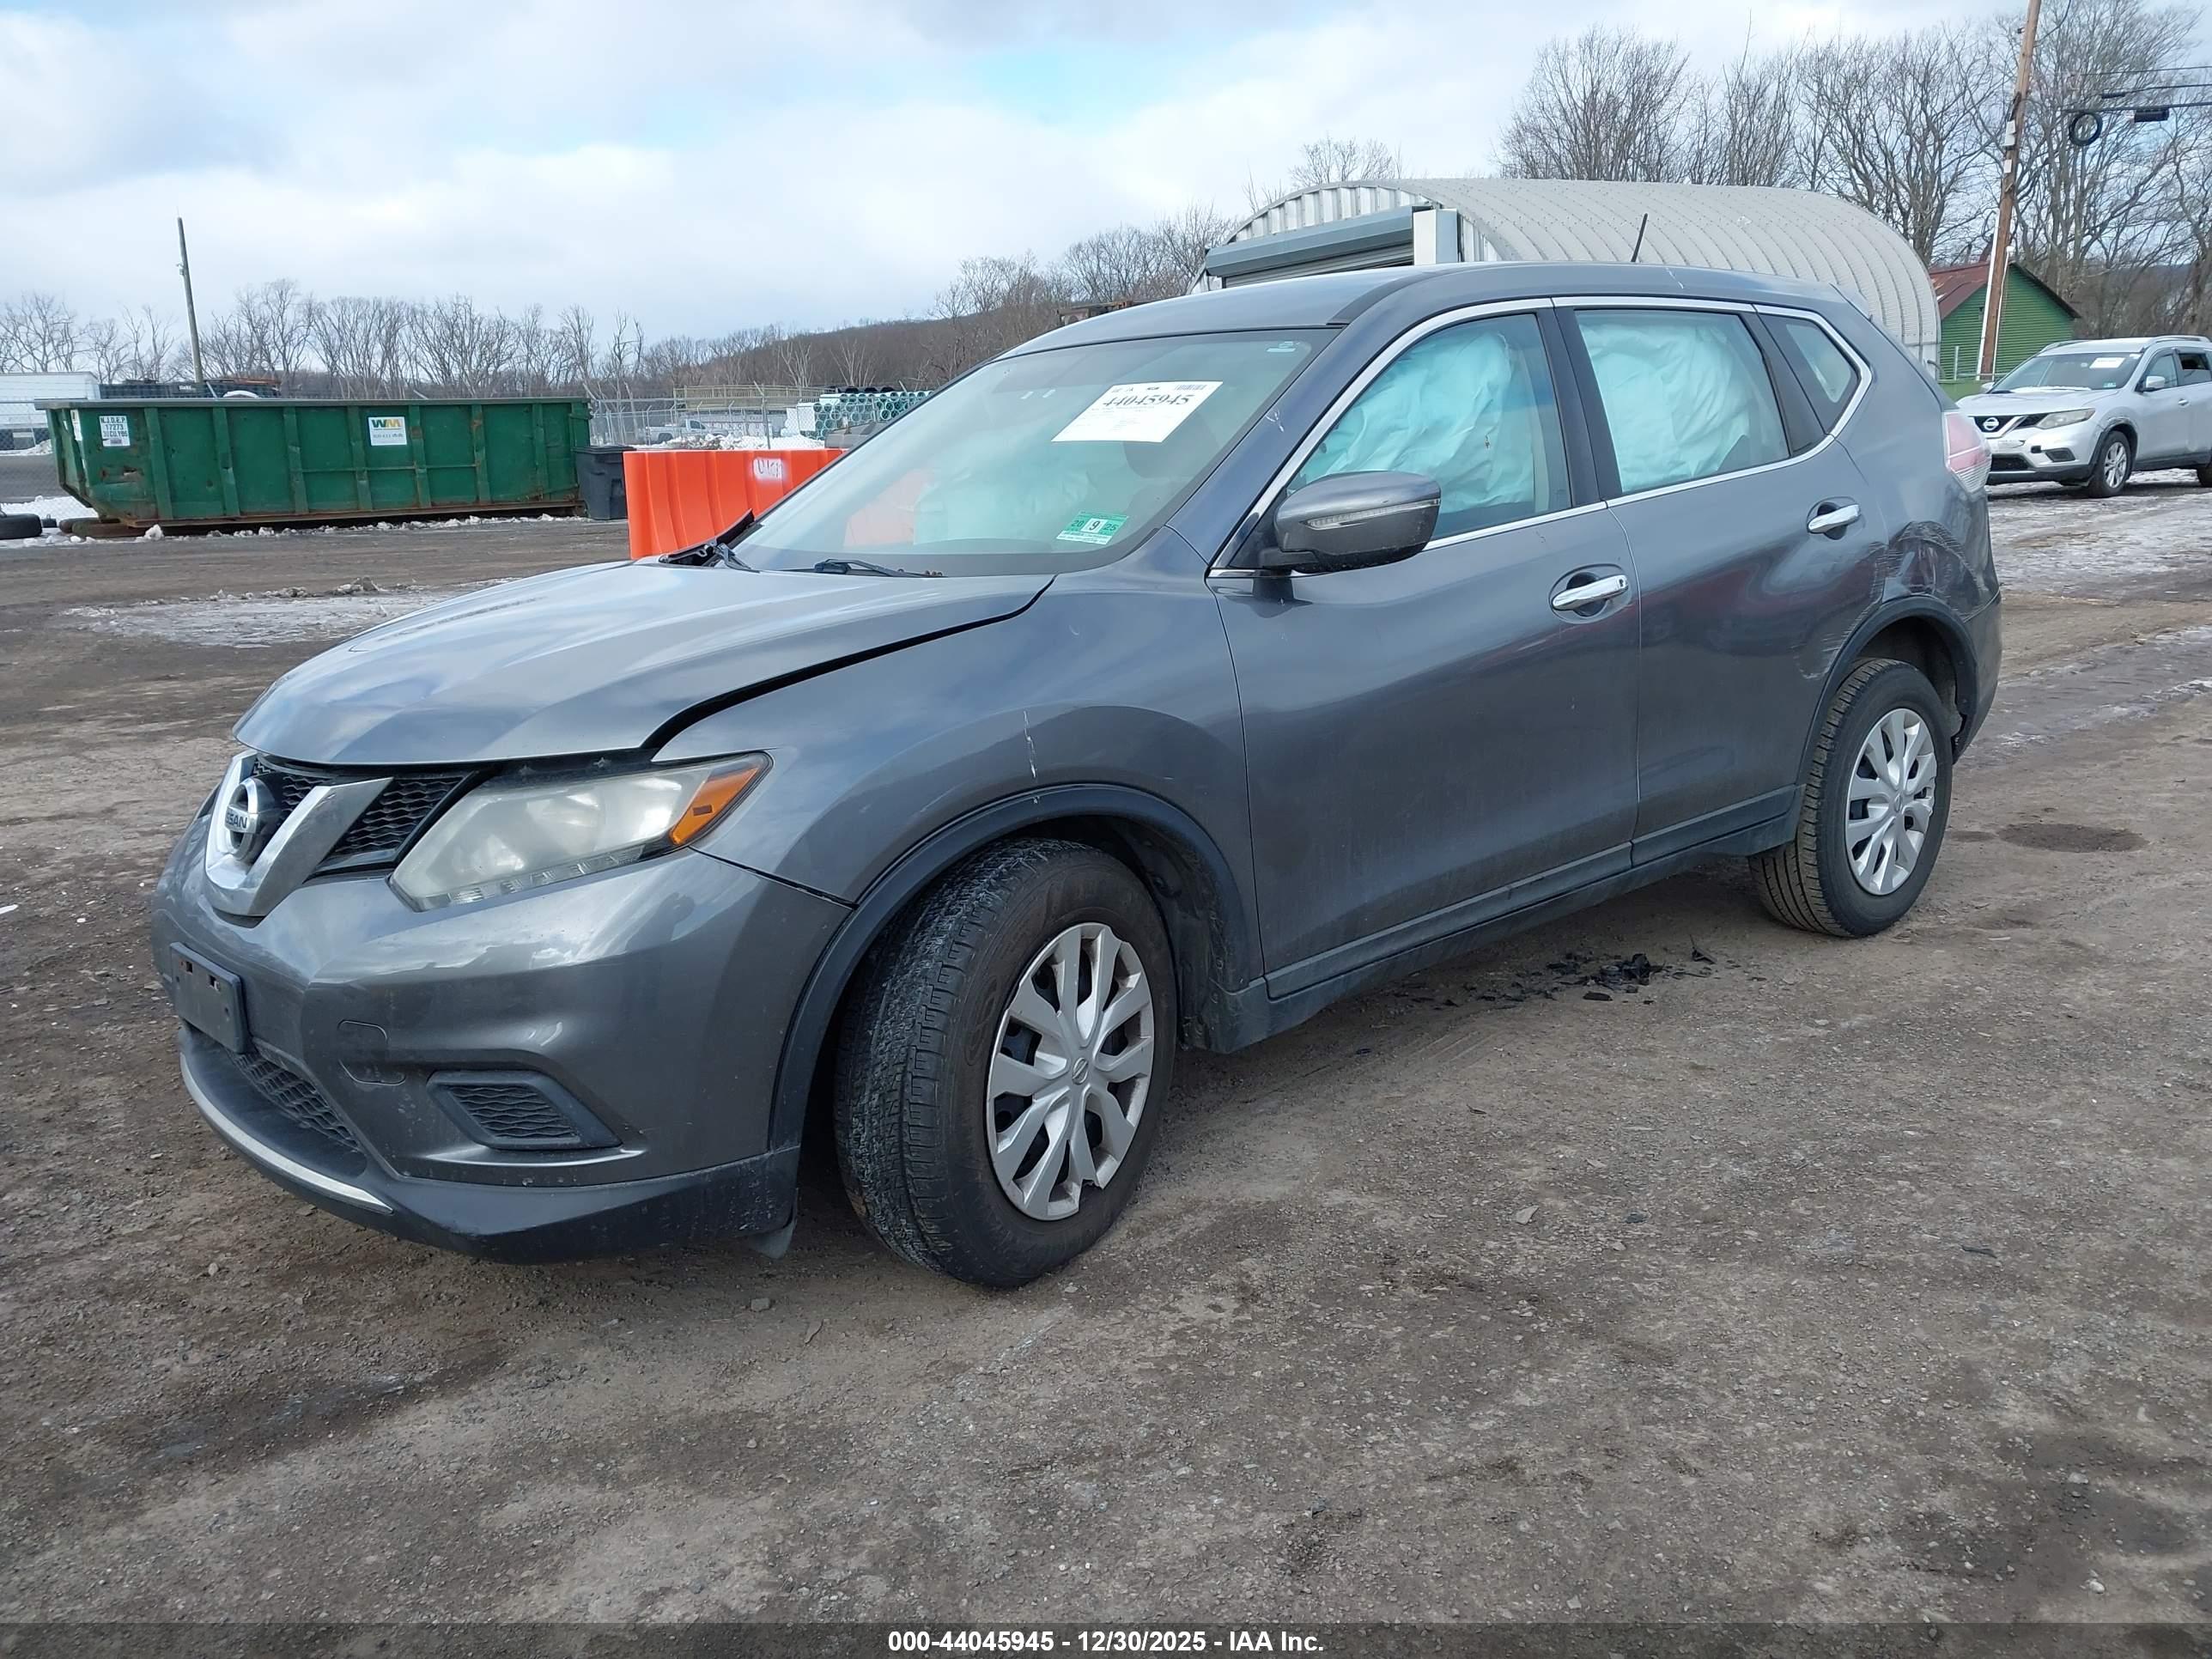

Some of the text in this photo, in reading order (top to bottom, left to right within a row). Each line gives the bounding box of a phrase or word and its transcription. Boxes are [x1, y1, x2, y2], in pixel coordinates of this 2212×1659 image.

[1103, 393, 1194, 406] 44045945
[371, 419, 401, 428] WM
[1089, 520, 1101, 531] 9
[226, 811, 248, 829] SSAN
